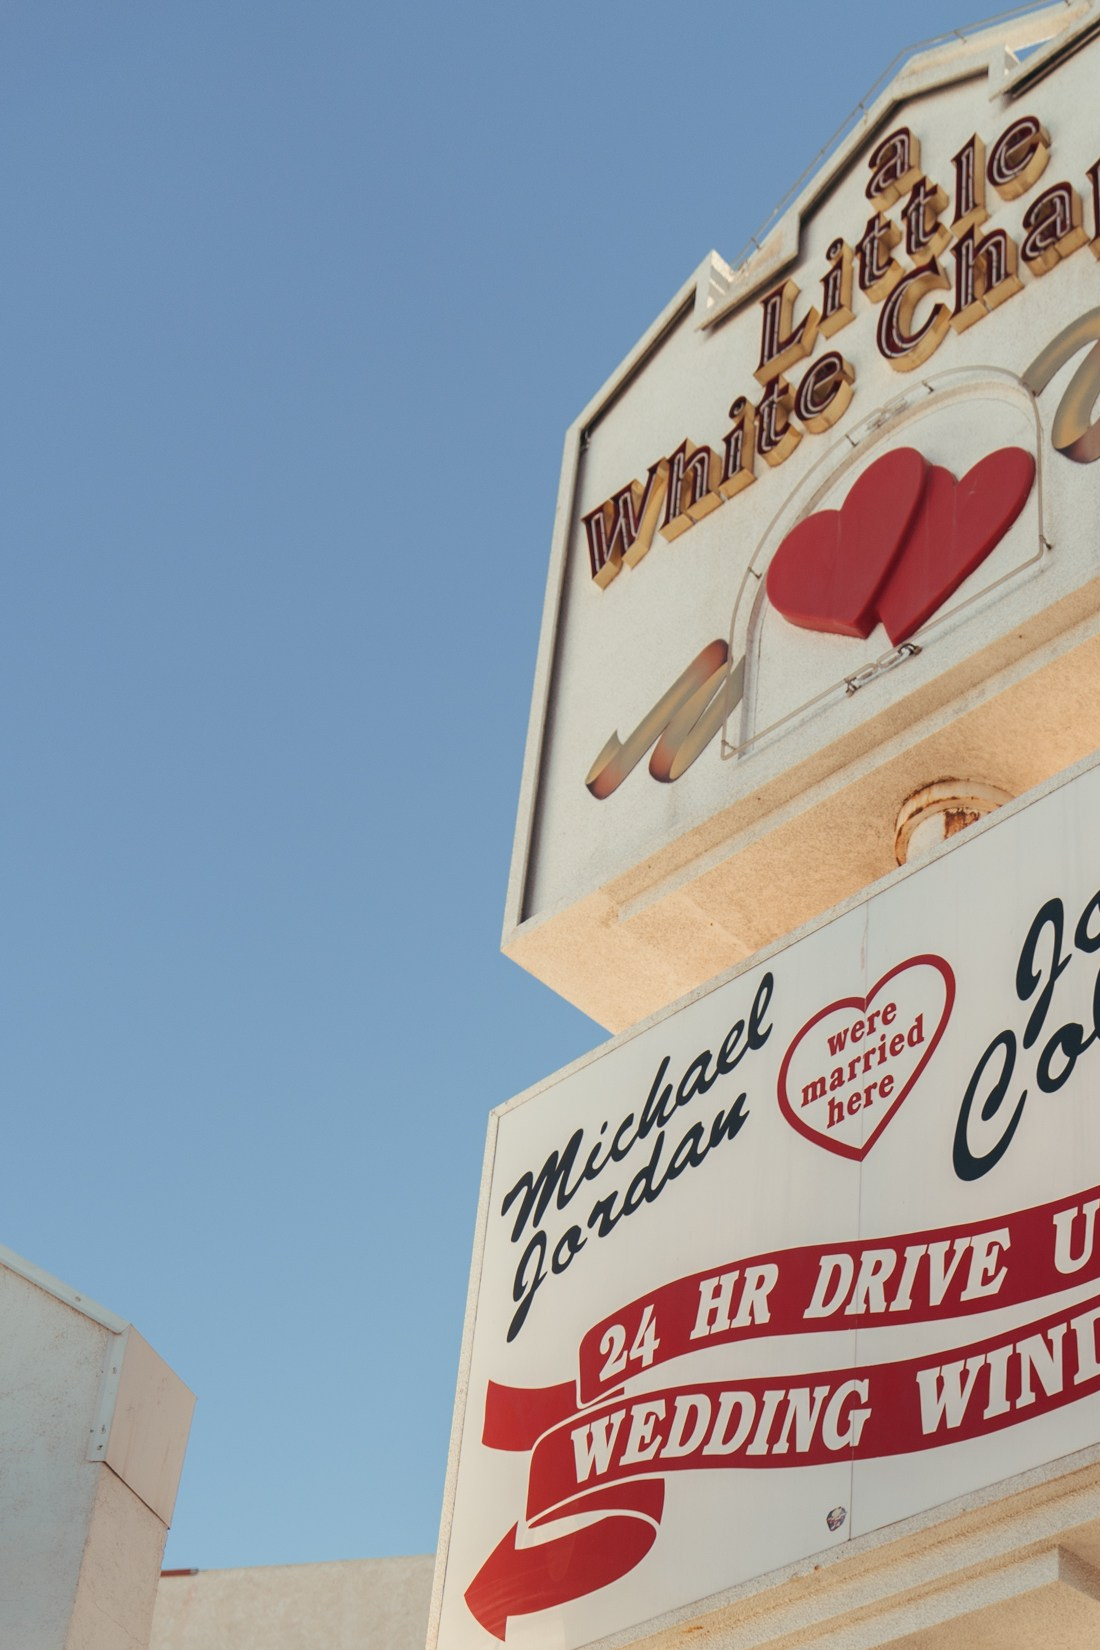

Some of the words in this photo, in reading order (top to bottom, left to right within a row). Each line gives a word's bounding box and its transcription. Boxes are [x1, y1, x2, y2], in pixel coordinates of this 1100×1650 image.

[864, 126, 921, 212] a
[753, 115, 1051, 385] Little
[580, 350, 857, 591] White
[801, 1015, 925, 1107] married
[827, 1003, 897, 1055] were
[501, 971, 775, 1243] Michael
[827, 1074, 894, 1128] here
[506, 1092, 750, 1342] Jordan
[599, 1305, 661, 1381] 24
[689, 1264, 779, 1340] HR
[802, 1228, 1011, 1319] DRIVE
[570, 1379, 872, 1484] WEDDING
